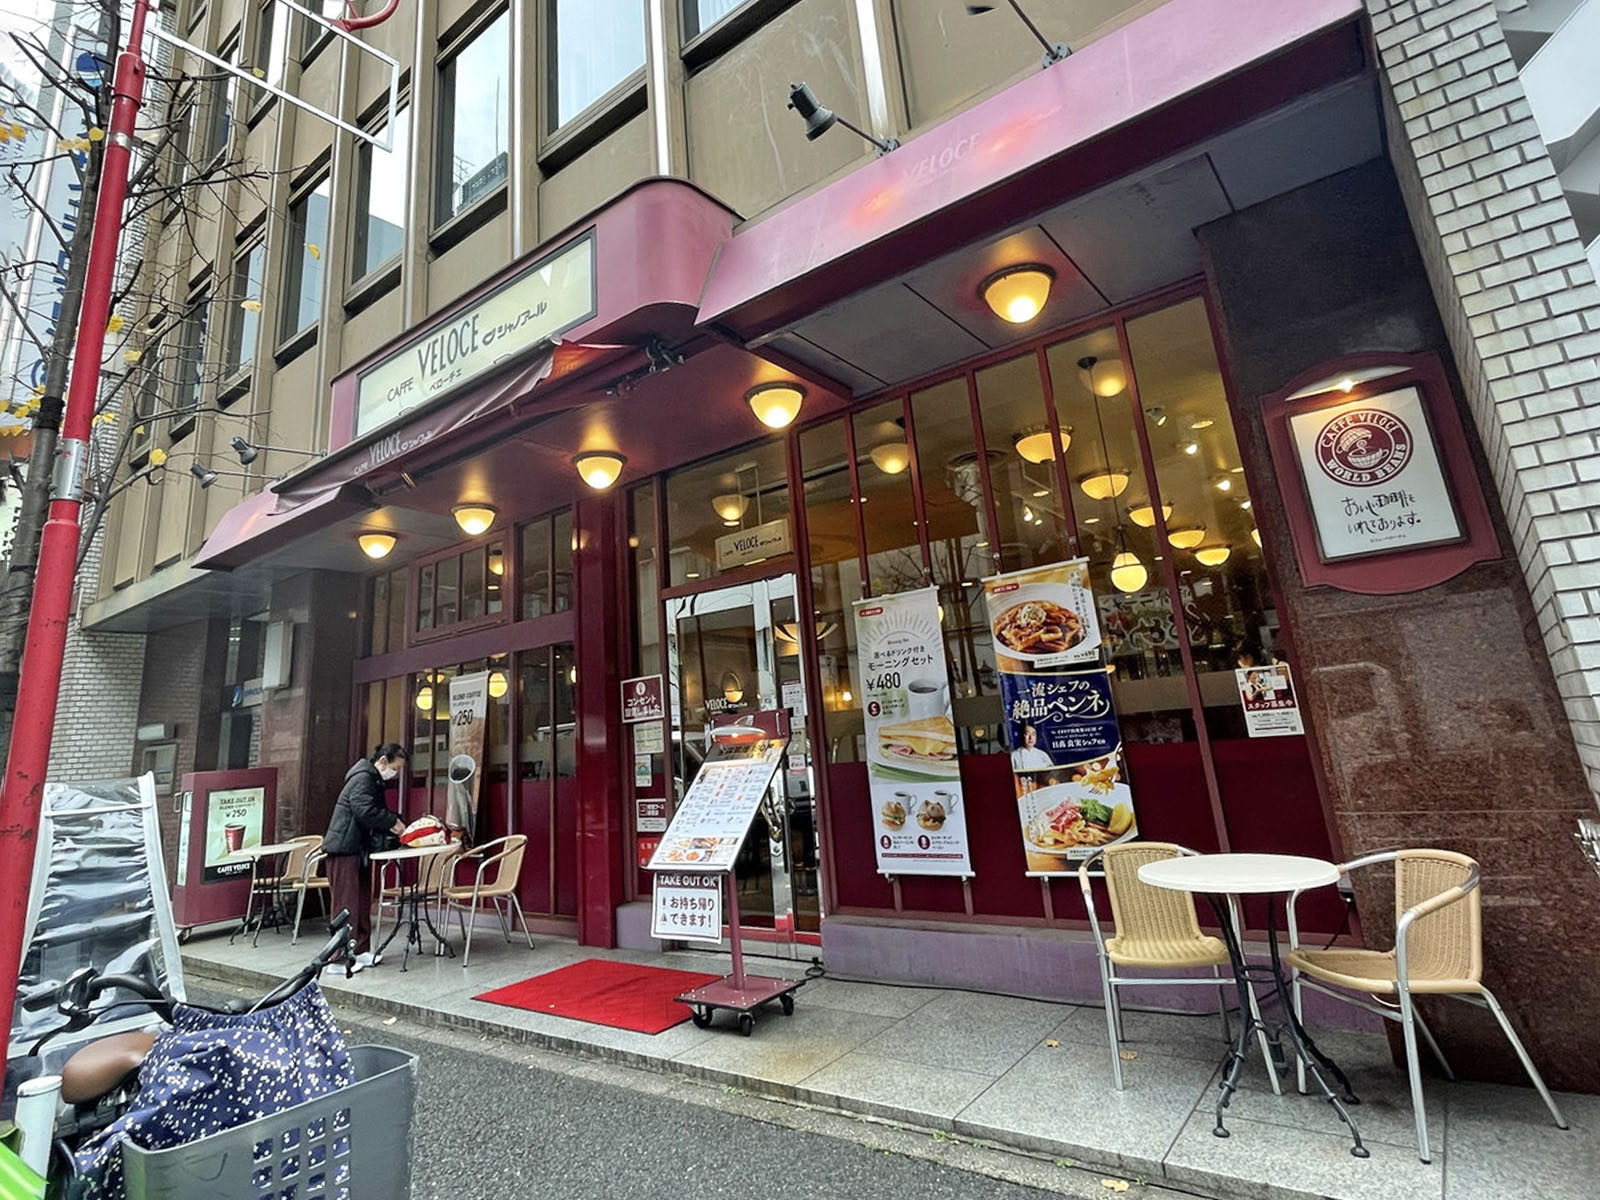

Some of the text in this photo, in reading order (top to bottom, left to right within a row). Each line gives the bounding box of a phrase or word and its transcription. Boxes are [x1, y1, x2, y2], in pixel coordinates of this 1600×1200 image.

[387, 376, 414, 402] CAFFE
[418, 313, 480, 380] VELOCE
[1321, 411, 1401, 448] CAFFE VELOCE
[369, 431, 401, 466] VELOCE
[1326, 443, 1408, 483] WORLD BEANS
[734, 534, 759, 552] VELOCE
[867, 654, 934, 672] モーニングセット
[866, 671, 902, 692] ¥480
[1017, 680, 1091, 697] 一流シェフの
[626, 694, 657, 707] コンセント
[705, 698, 728, 711] VELOCE
[1011, 690, 1104, 720] 絶品ペンネ
[660, 875, 717, 887] TAKE OUT OK
[670, 896, 715, 912] お持ち帰り
